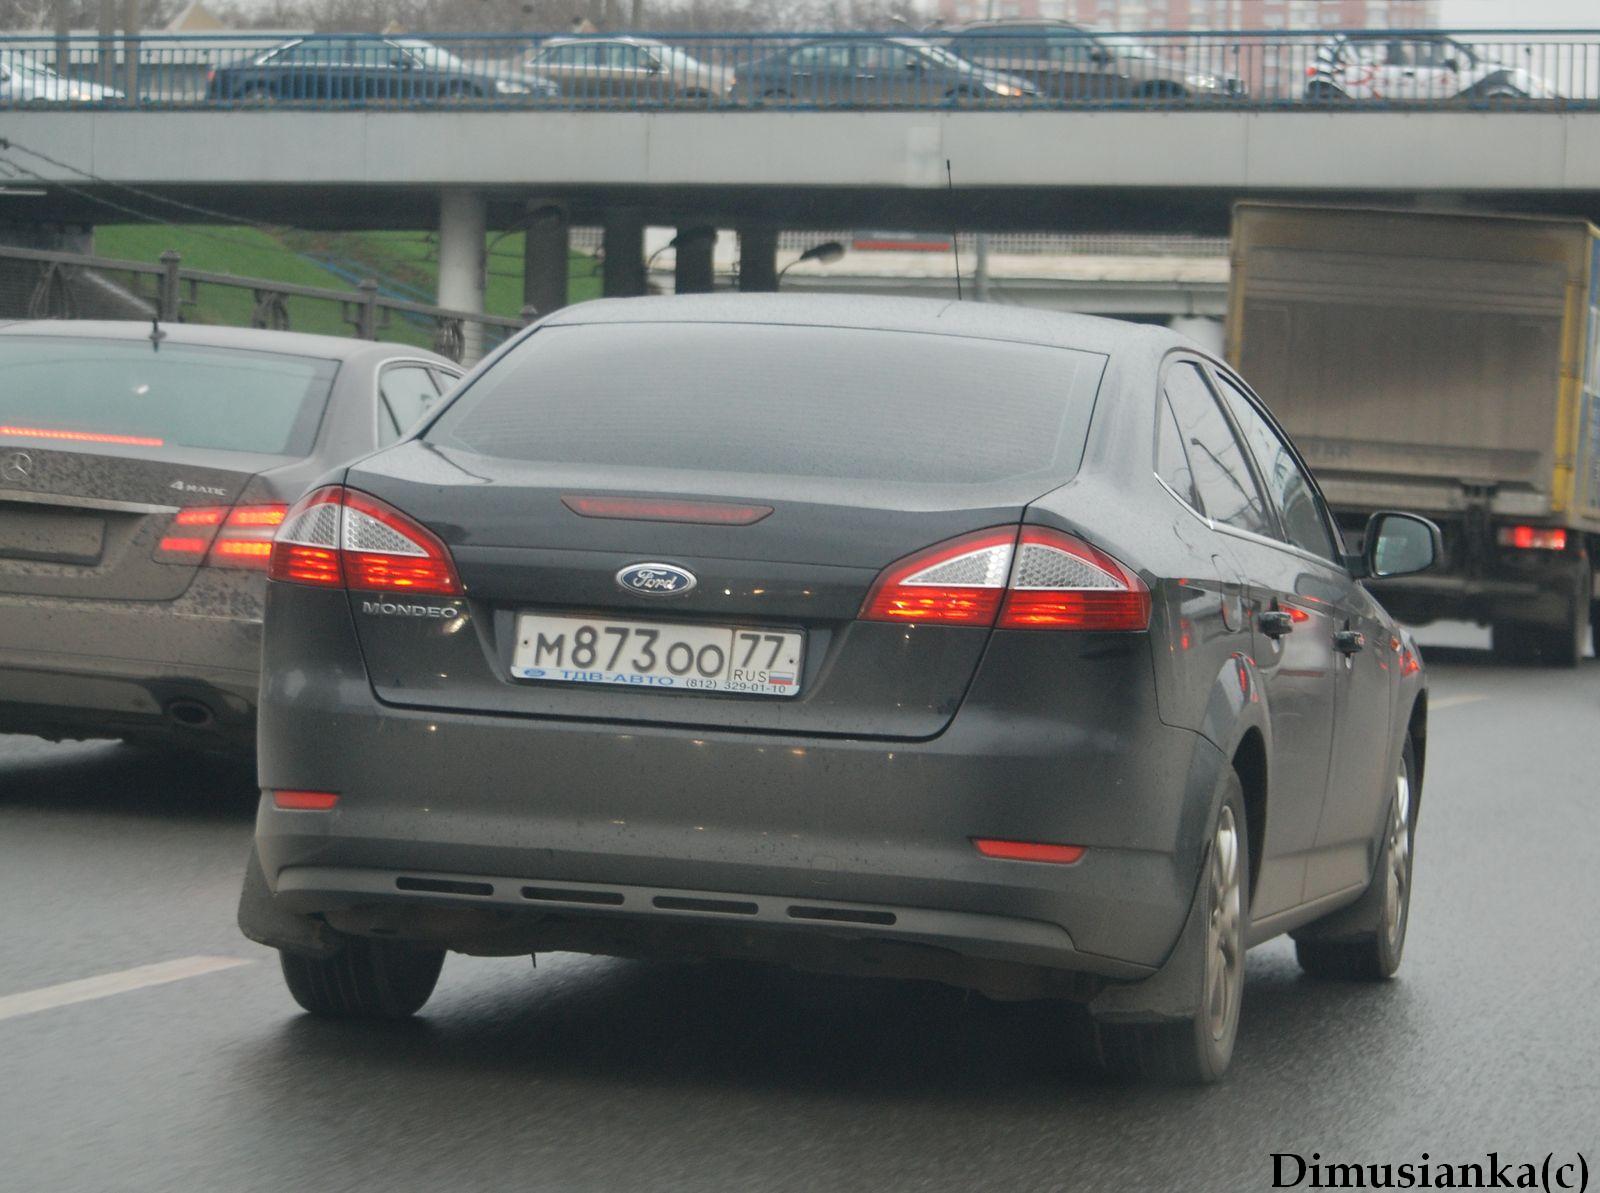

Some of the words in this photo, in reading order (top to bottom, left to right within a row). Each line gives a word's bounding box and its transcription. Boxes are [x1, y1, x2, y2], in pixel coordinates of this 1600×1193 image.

[632, 570, 677, 590] Ford
[362, 601, 458, 619] MONDEO
[739, 633, 785, 669] 77
[559, 670, 674, 686] ТДВ-АВТО
[733, 670, 767, 683] RUS
[685, 678, 717, 690] (812)
[723, 680, 787, 694] 329-01-10
